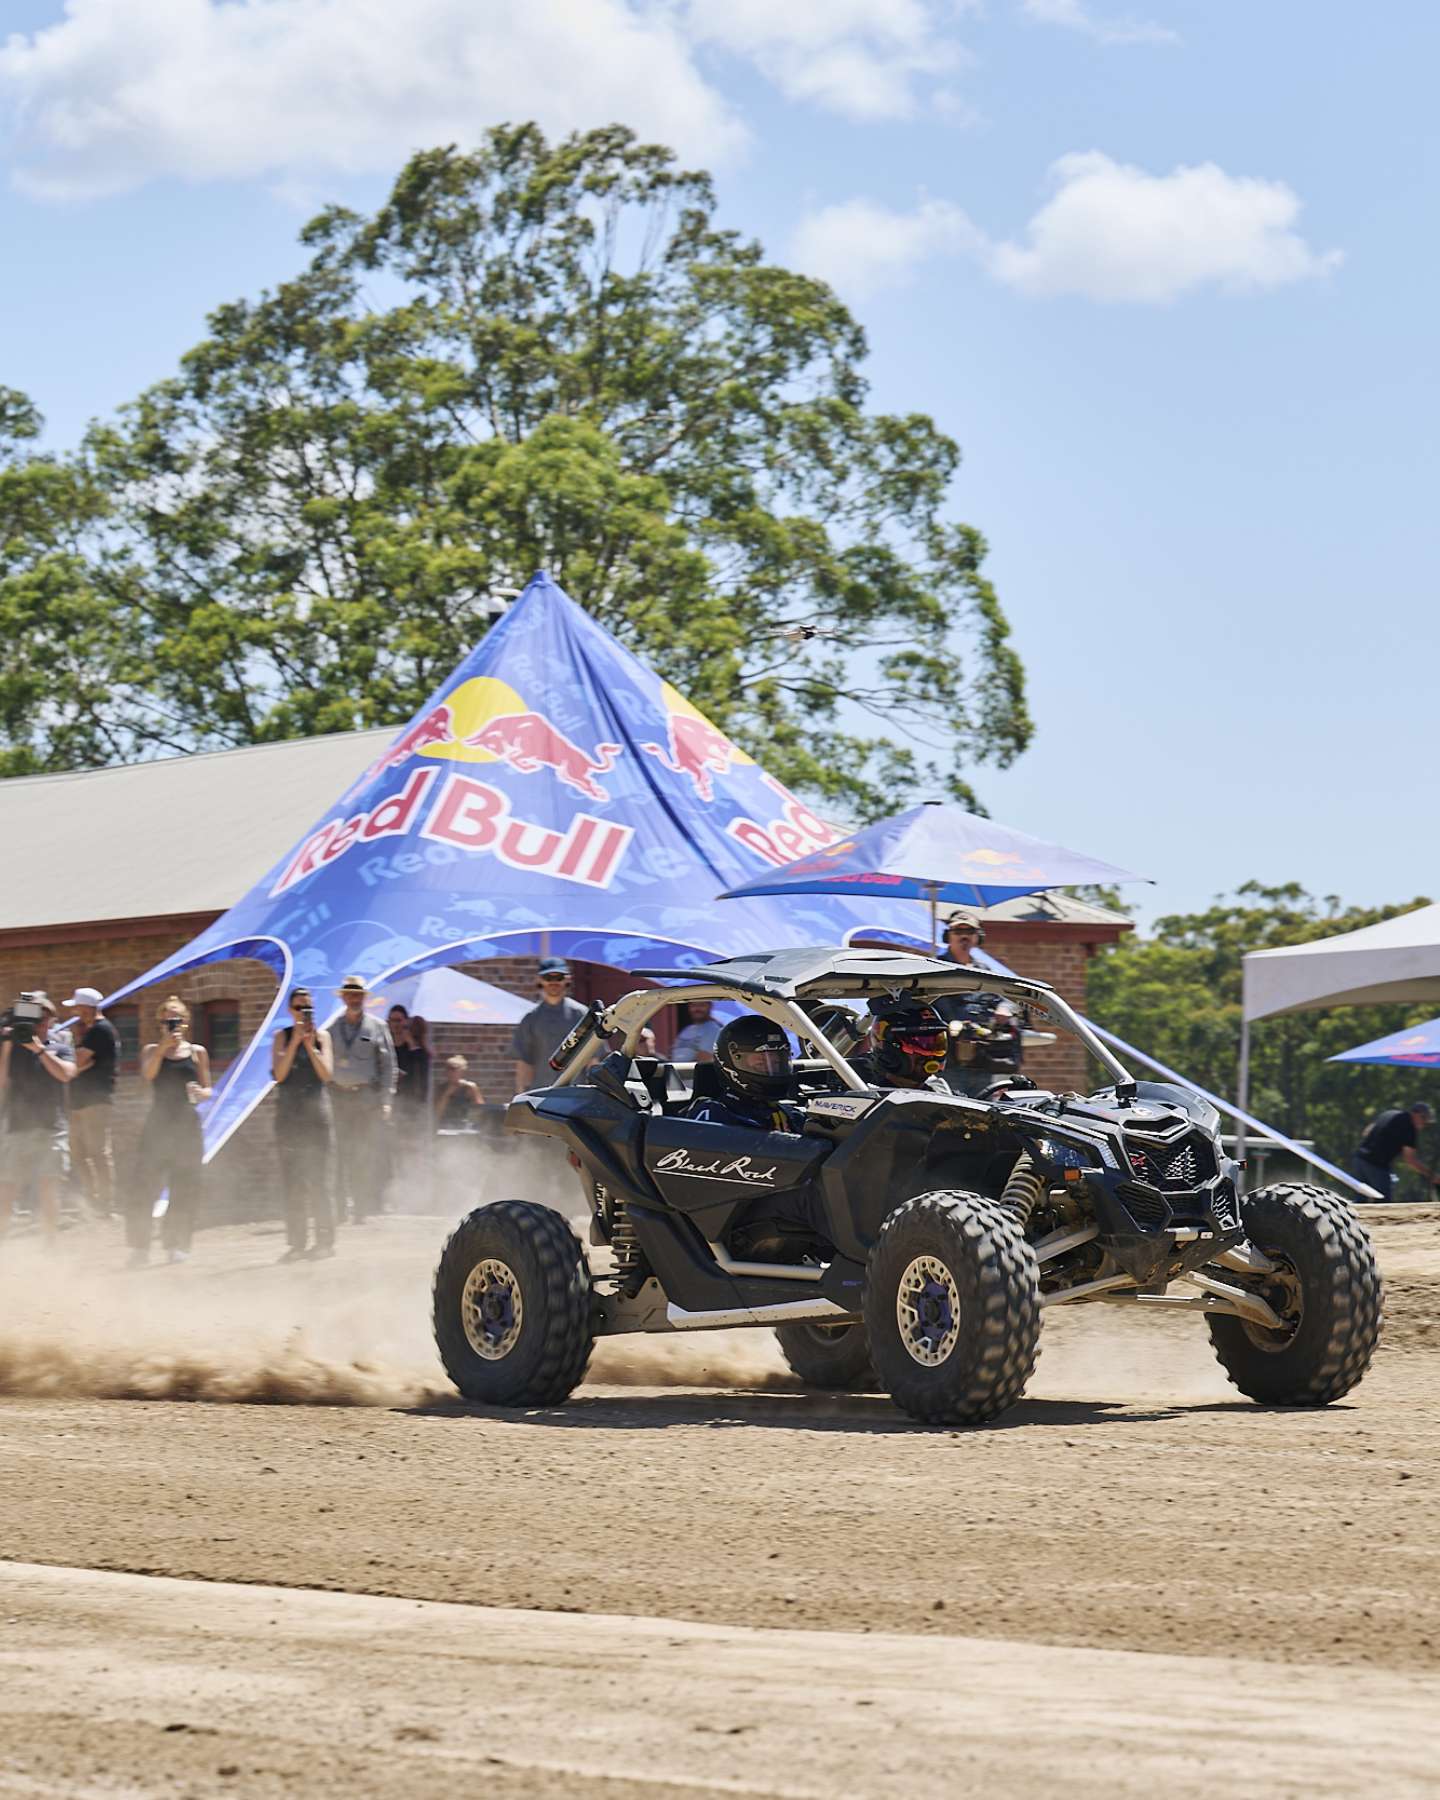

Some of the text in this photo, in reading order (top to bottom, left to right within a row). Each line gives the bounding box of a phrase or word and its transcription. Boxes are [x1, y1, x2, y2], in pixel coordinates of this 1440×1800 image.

[269, 766, 635, 898] Red Bull
[814, 1100, 858, 1114] MAVERICK
[656, 1147, 778, 1181] Black Rock
